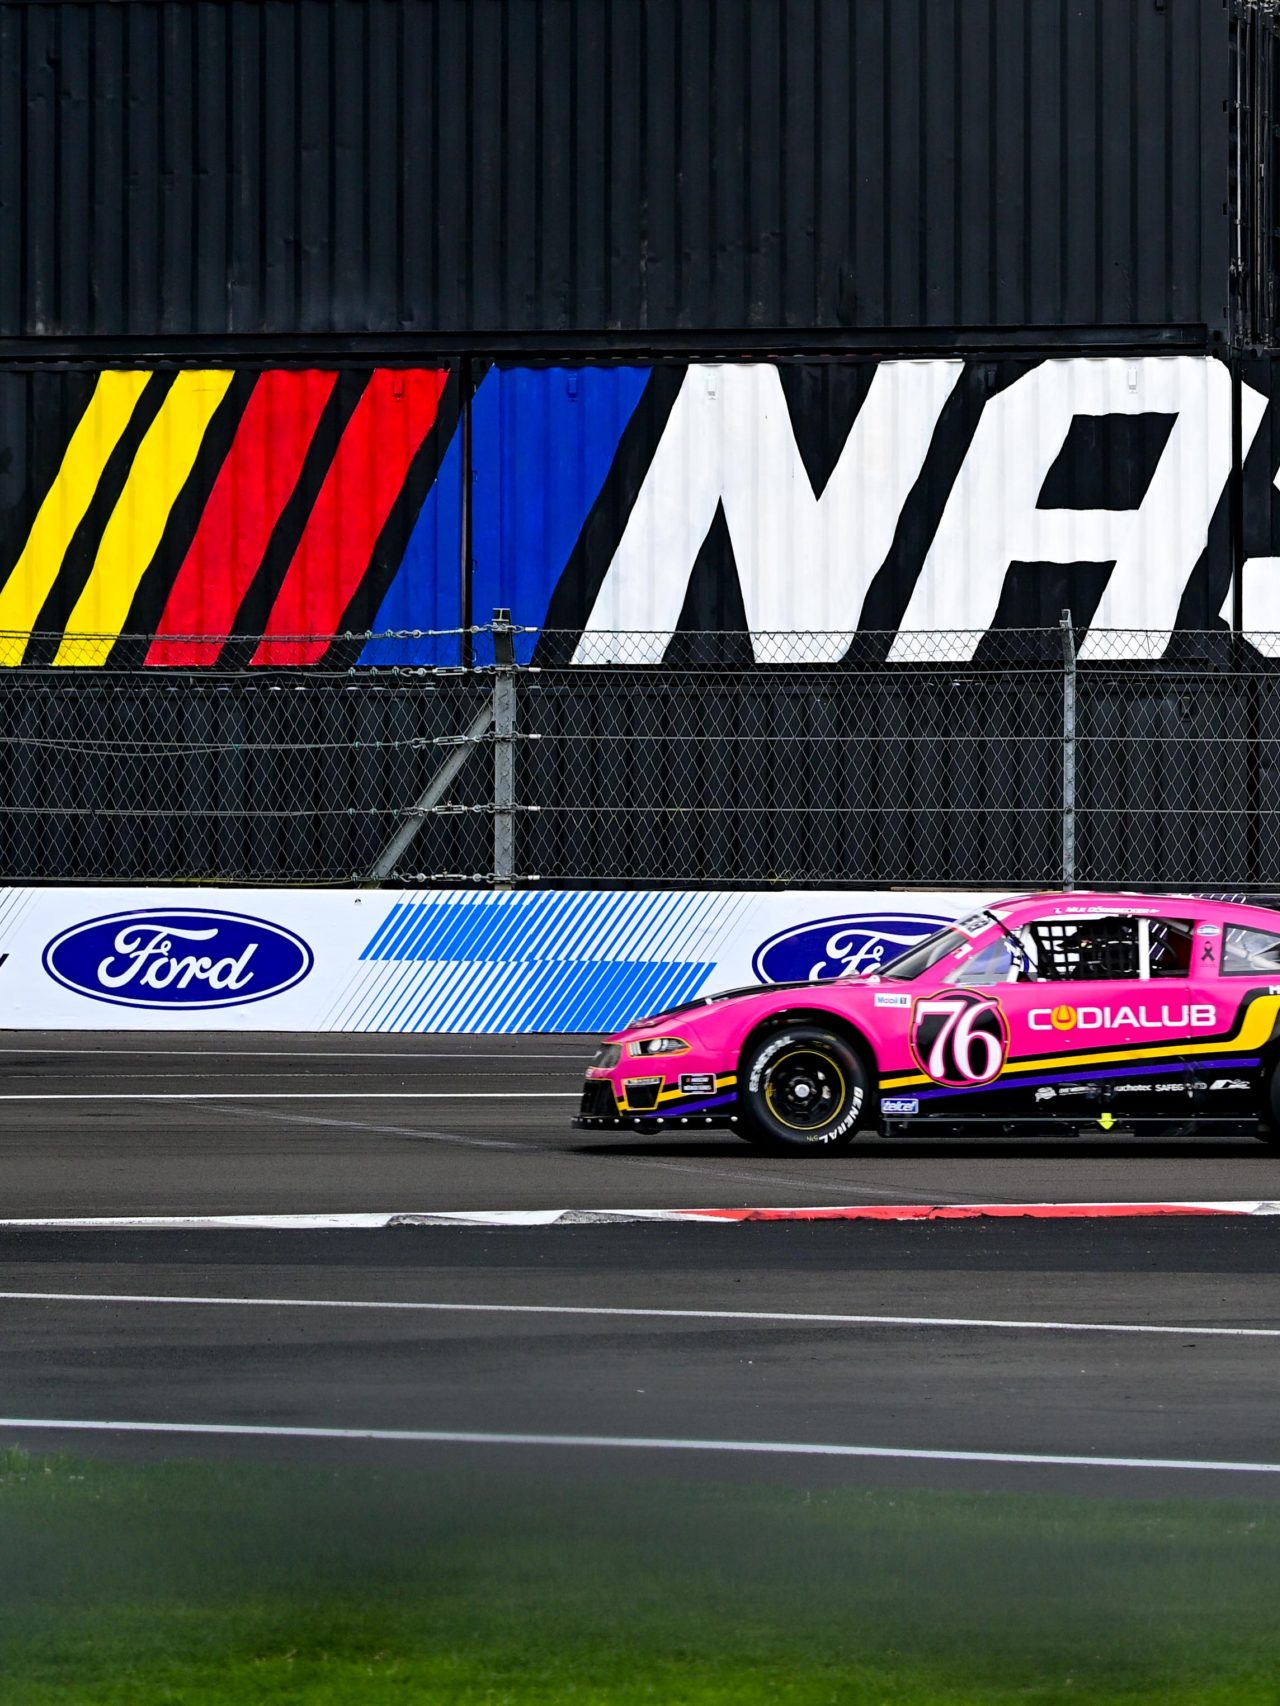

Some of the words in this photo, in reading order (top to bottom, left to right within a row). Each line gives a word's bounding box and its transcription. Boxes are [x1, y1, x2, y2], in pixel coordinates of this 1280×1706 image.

[97, 924, 254, 990] Ford
[915, 999, 1003, 1081] 76
[1027, 1004, 1217, 1031] CODIALUB
[818, 1086, 864, 1144] GENERAL
